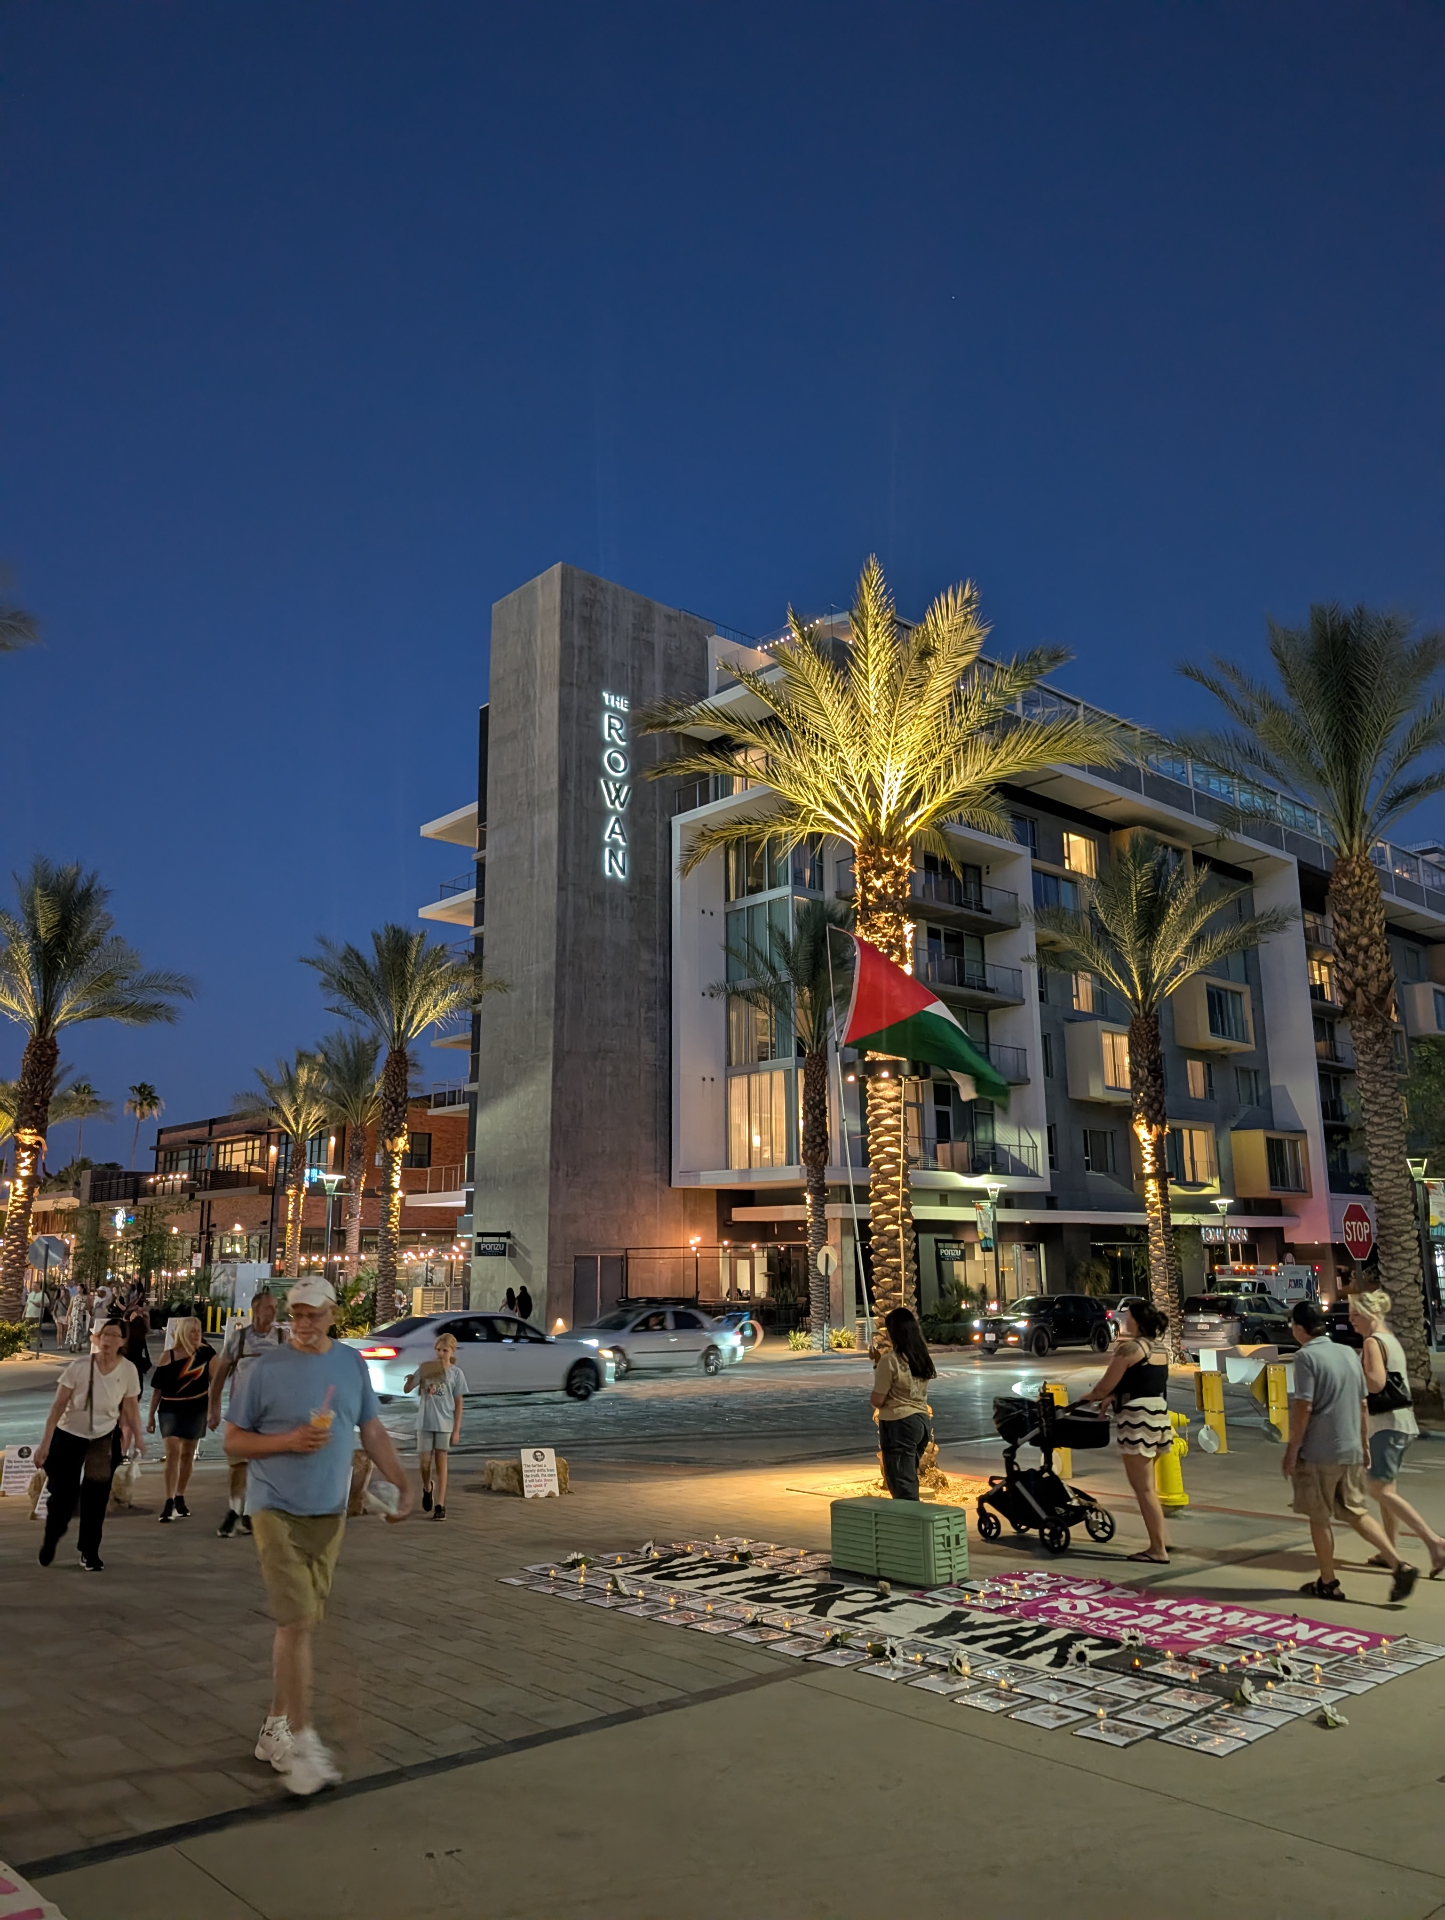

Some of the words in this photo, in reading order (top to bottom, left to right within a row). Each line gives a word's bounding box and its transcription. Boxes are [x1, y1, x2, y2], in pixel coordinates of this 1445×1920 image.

[603, 691, 630, 712] THE
[600, 713, 632, 879] ROWAN
[1345, 1221, 1370, 1242] STOP
[1288, 1279, 1304, 1288] AMR
[601, 1551, 749, 1582] NO
[694, 1572, 943, 1625] MORE
[908, 1610, 1128, 1669] WAR
[1009, 1573, 1139, 1599] STOP
[1134, 1599, 1370, 1648] ARMING
[1038, 1598, 1223, 1642] ISRAEL
